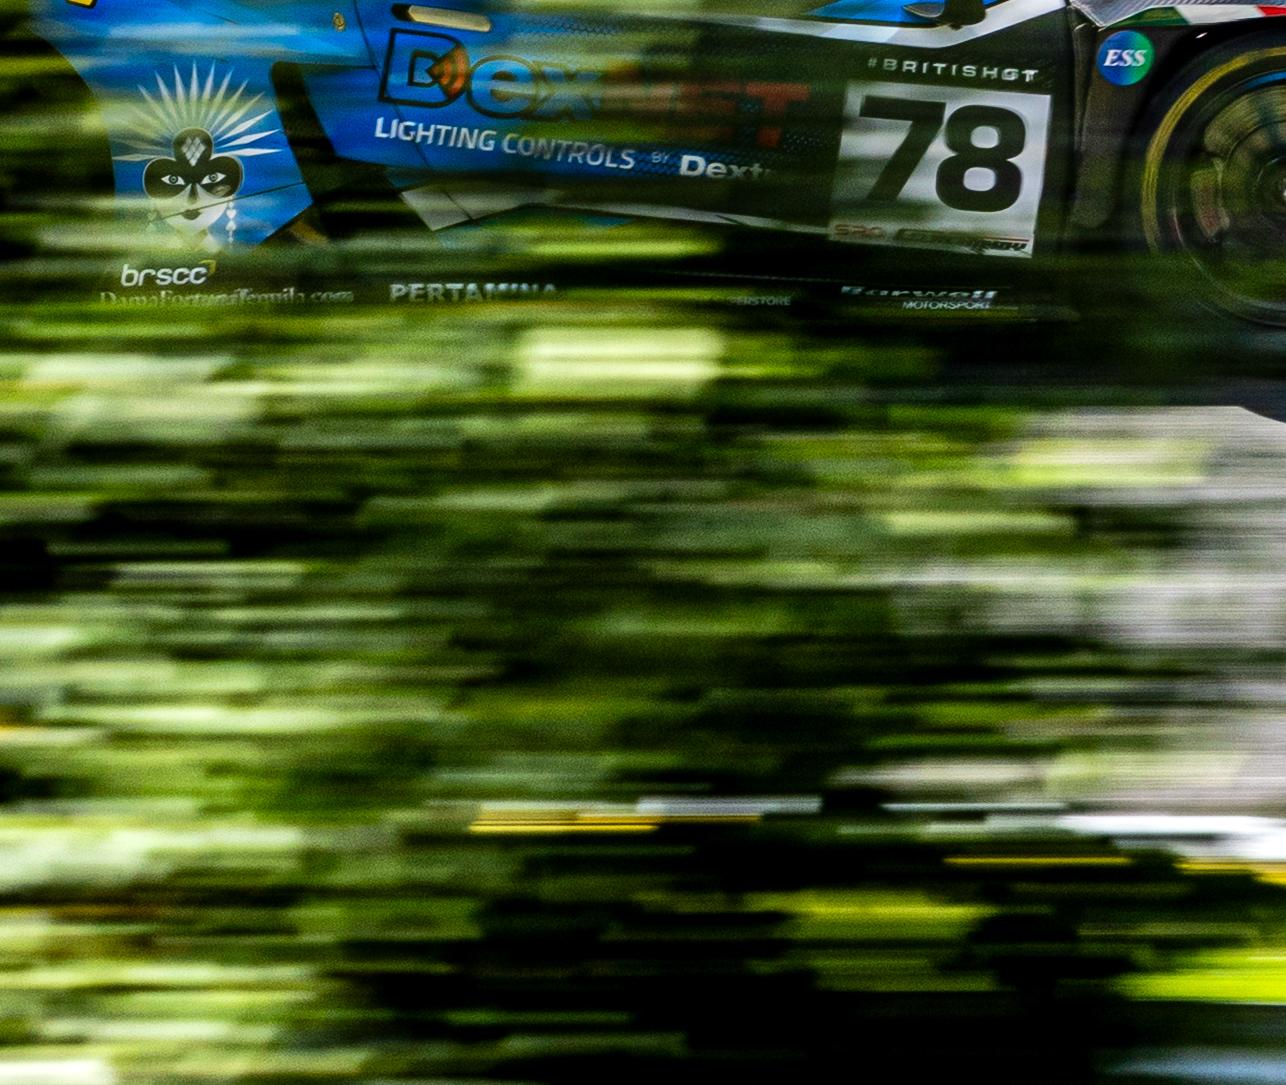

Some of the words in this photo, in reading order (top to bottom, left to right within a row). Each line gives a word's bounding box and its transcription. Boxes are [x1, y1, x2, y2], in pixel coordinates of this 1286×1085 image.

[867, 57, 1039, 83] #BRITISHGT
[1103, 48, 1148, 67] ESS
[374, 117, 496, 152] LIGHTING
[502, 132, 636, 170] CONTROLS
[859, 94, 1027, 213] 78
[119, 263, 208, 287] brscc
[902, 300, 991, 311] MOTORSPORT
